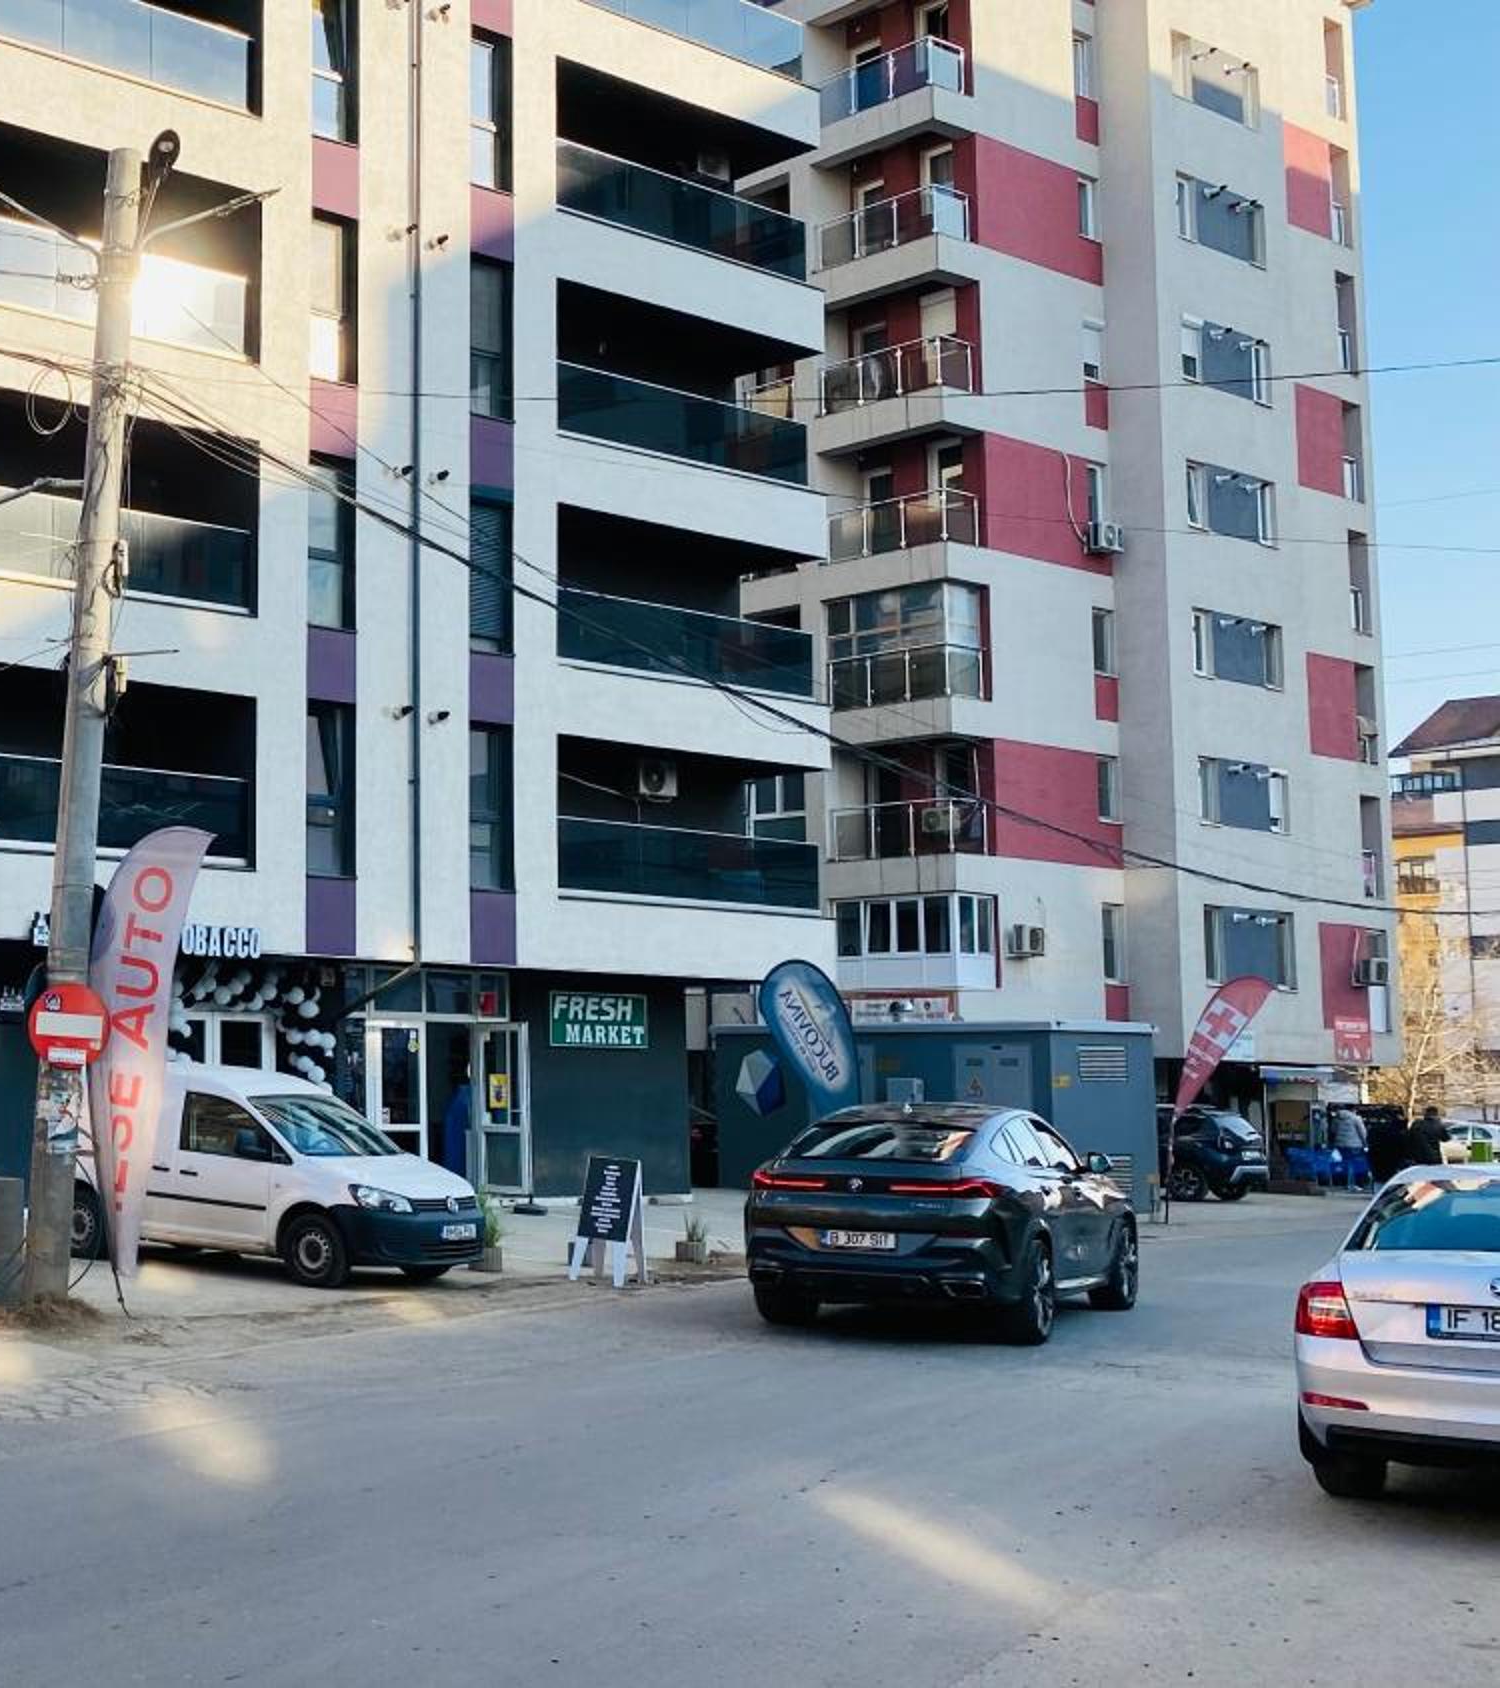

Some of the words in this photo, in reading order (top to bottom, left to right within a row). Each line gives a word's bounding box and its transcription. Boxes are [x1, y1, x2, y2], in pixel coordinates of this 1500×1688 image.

[181, 923, 261, 959] OBACCO
[111, 865, 174, 1052] AUTO
[553, 995, 633, 1022] FRESH
[565, 1023, 645, 1045] MARKET
[844, 1232, 867, 1245] 307
[1447, 1309, 1471, 1330] IF
